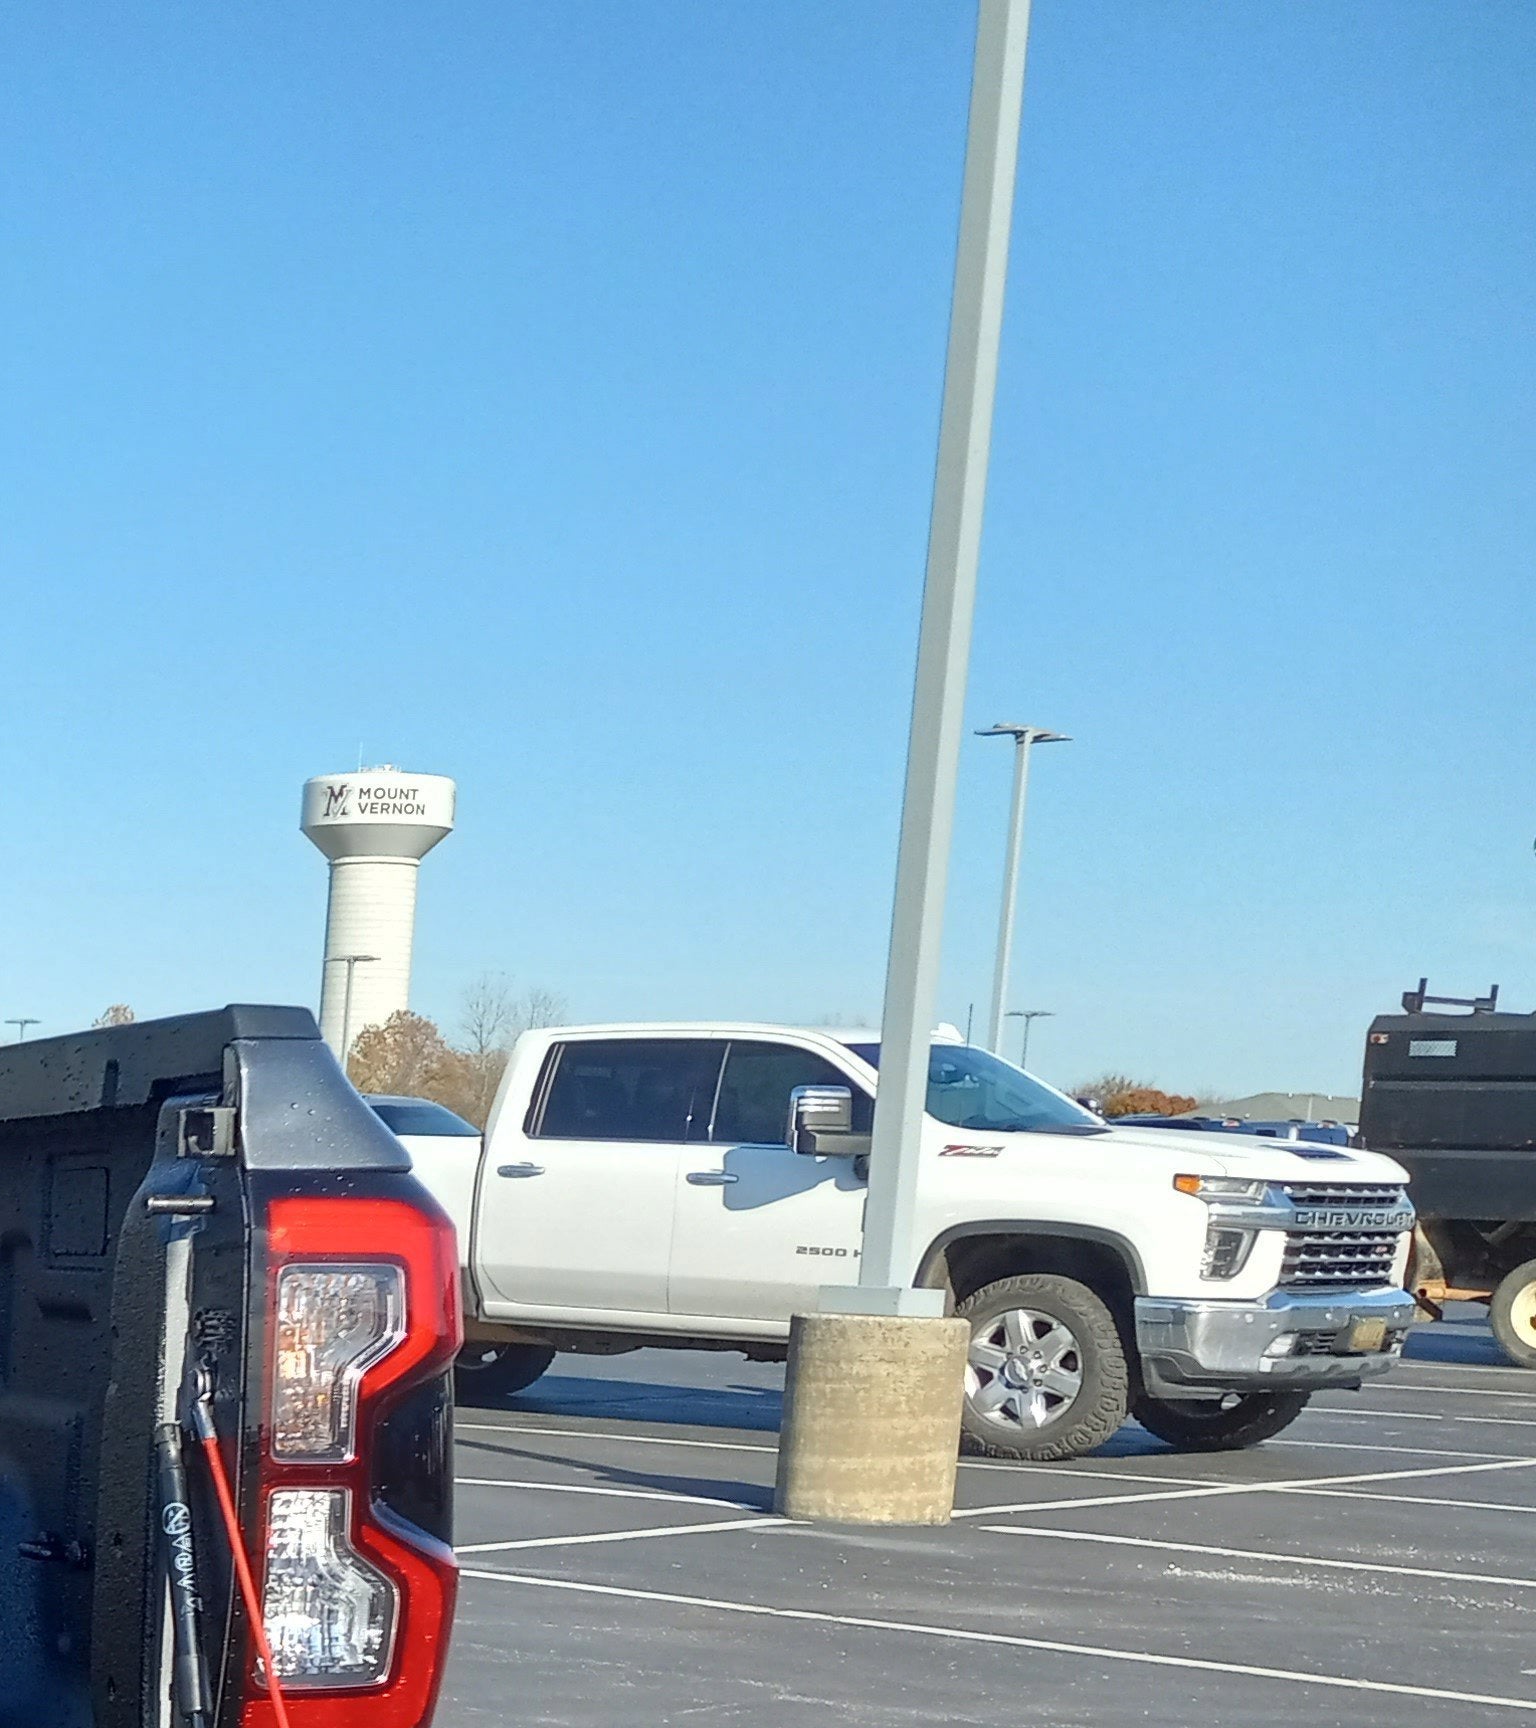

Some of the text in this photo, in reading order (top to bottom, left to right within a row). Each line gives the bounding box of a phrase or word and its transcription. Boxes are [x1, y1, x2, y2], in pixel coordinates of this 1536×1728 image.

[358, 787, 419, 801] MOUNT
[358, 802, 426, 816] VERNON
[1295, 1211, 1415, 1227] CHEVROLET
[795, 1245, 847, 1257] 2500
